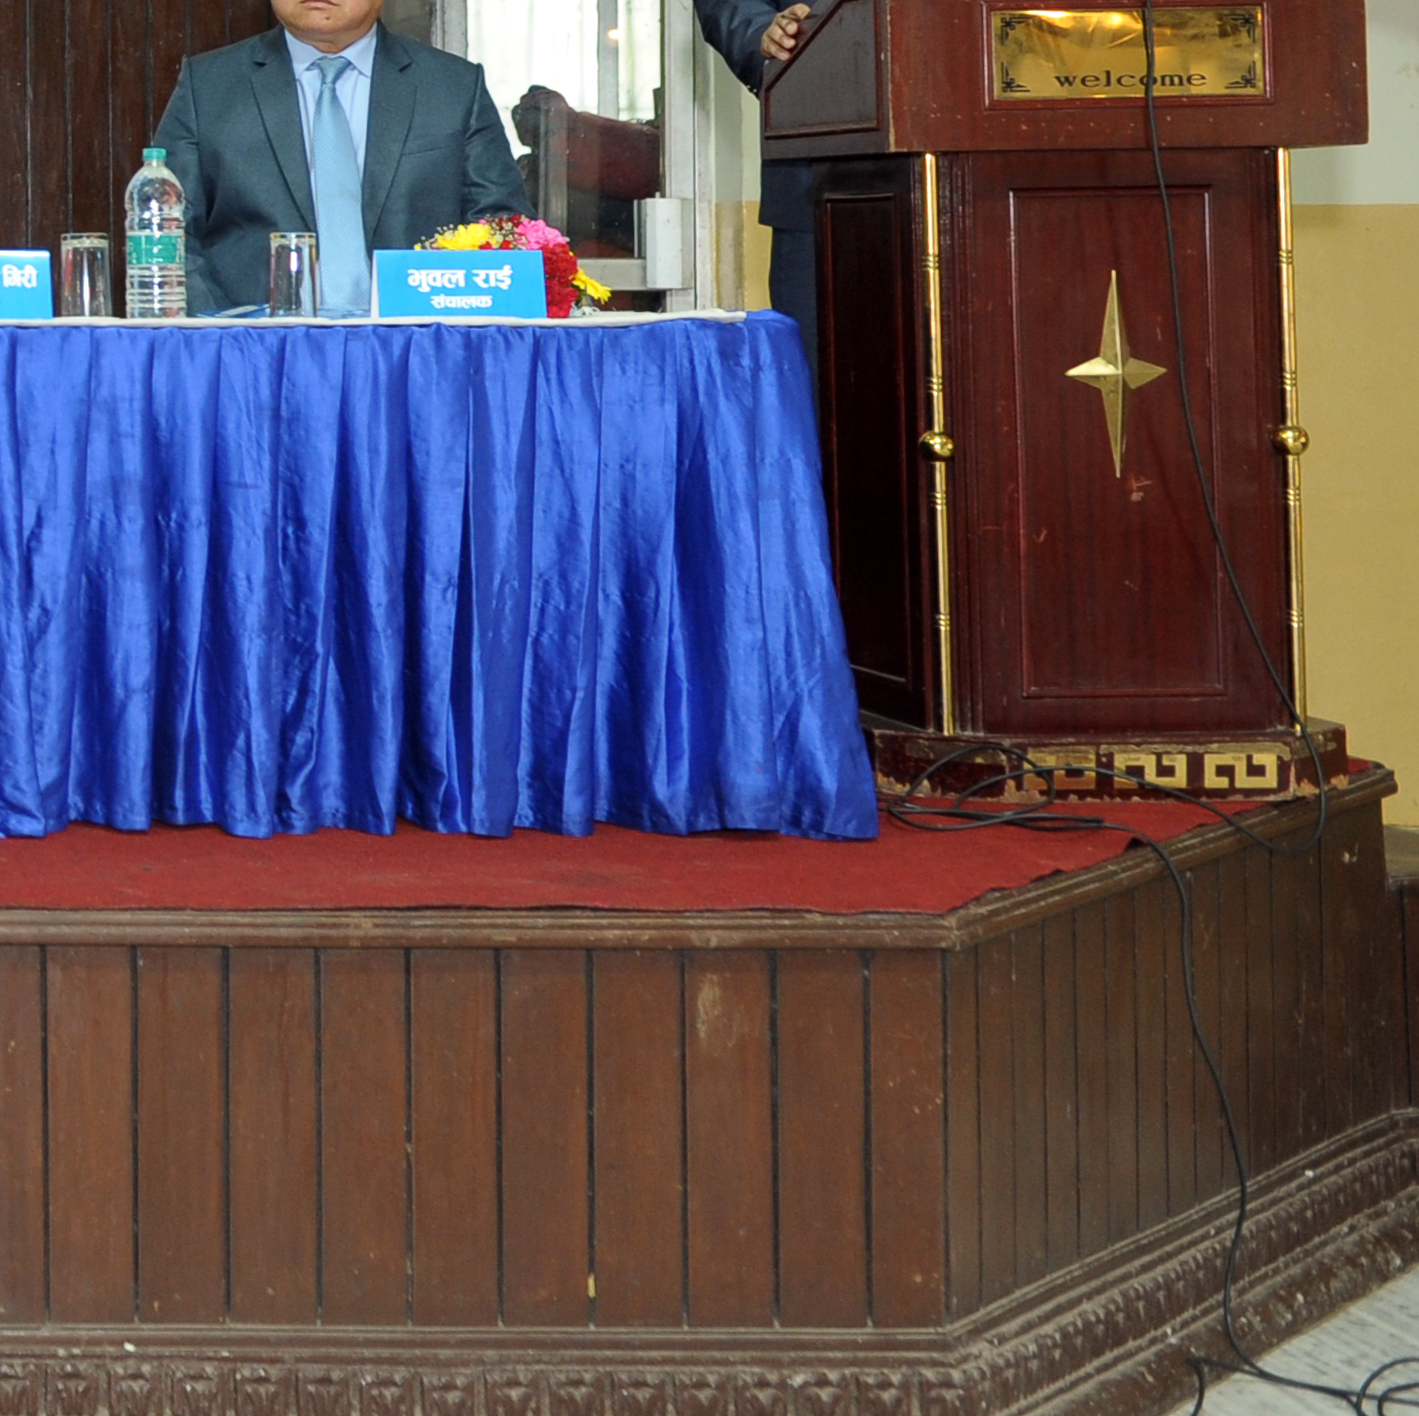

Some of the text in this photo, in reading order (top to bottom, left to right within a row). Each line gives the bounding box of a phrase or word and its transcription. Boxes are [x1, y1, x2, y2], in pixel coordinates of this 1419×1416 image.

[1054, 69, 1208, 89] welcome
[472, 264, 514, 290] राई
[430, 293, 494, 310] संचालक
